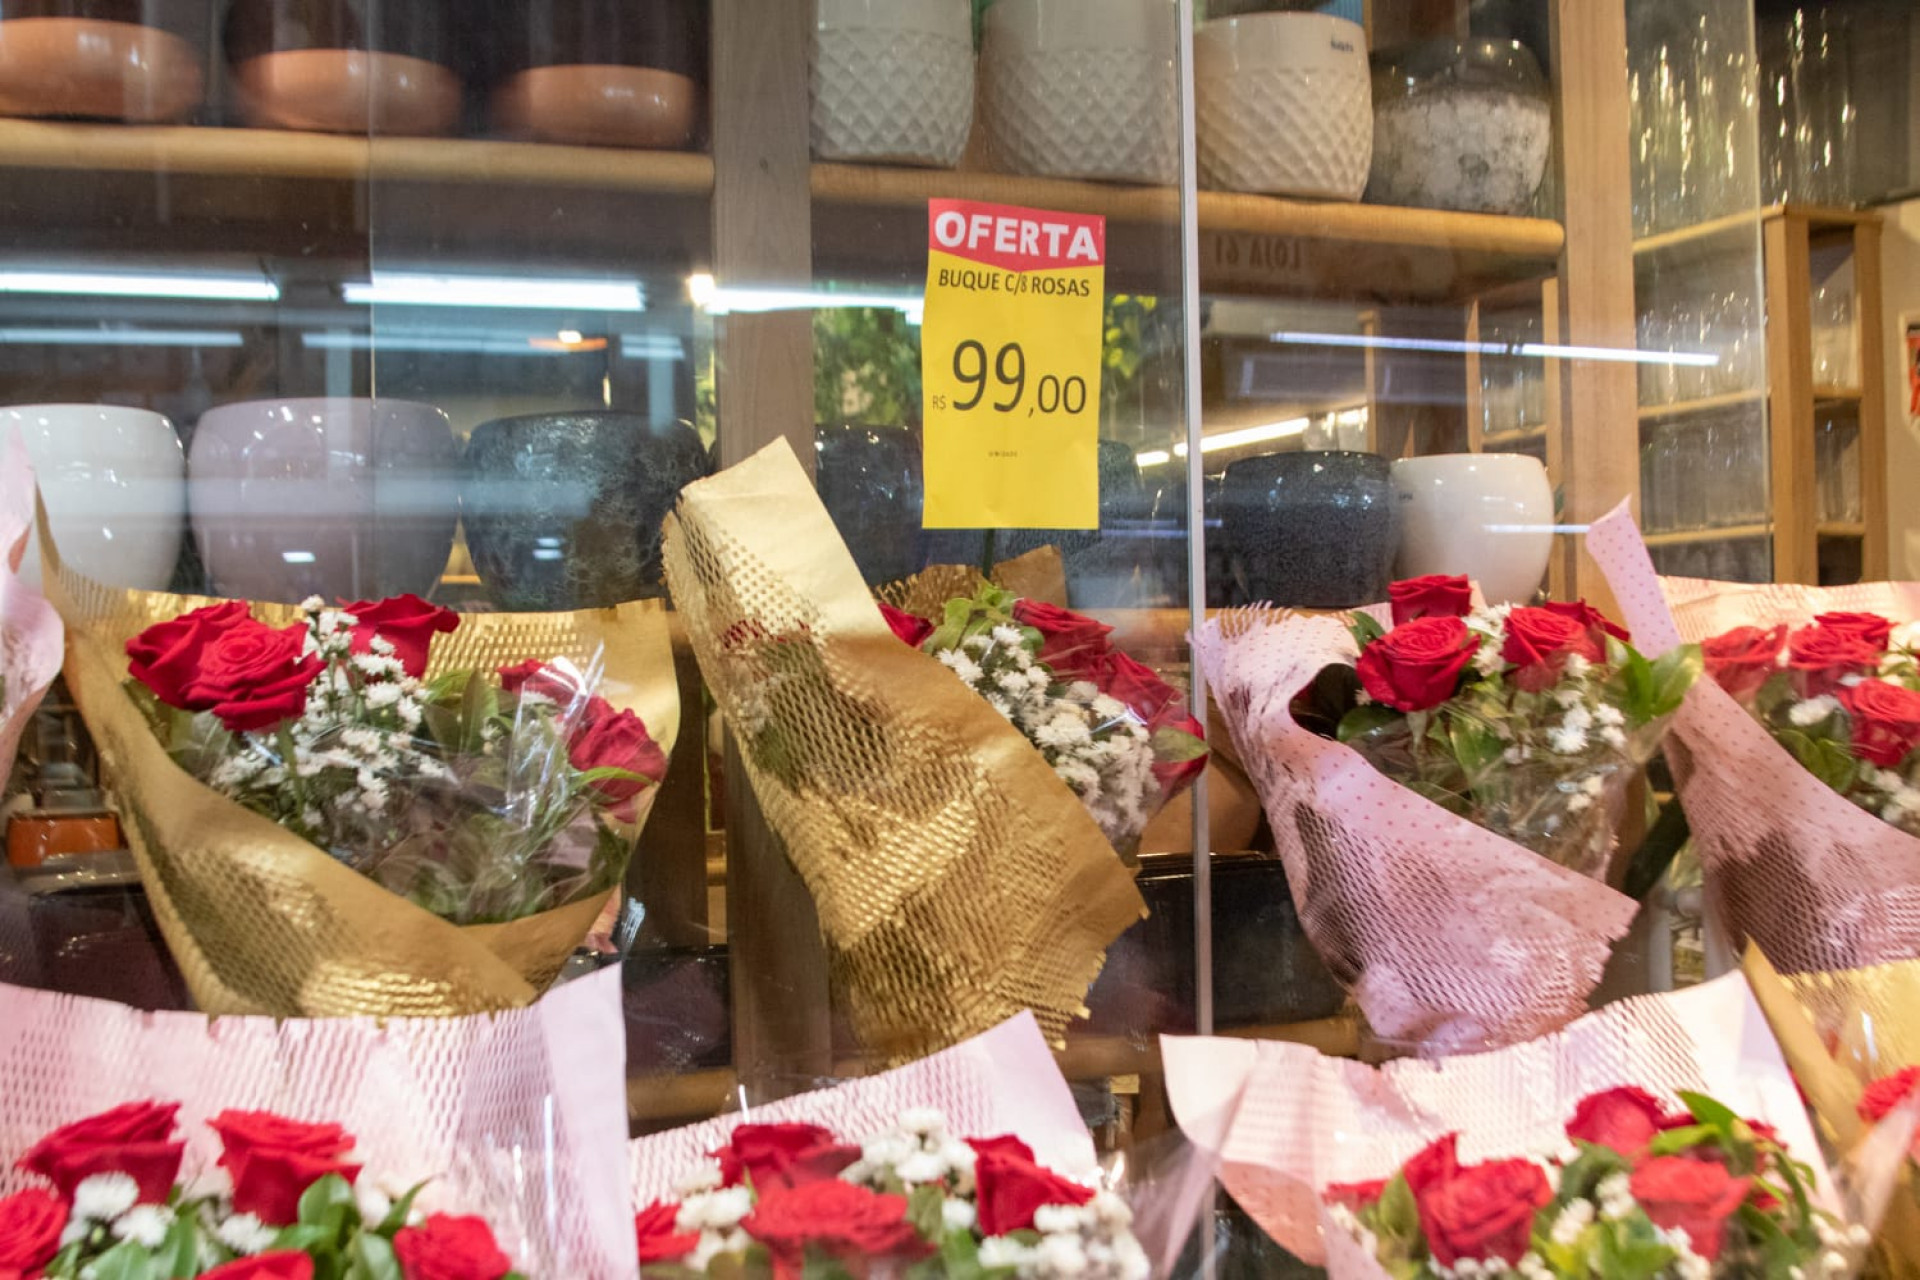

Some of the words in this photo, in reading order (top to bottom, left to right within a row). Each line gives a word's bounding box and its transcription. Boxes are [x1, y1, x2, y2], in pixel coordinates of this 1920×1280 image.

[934, 210, 1099, 262] OFERTA
[938, 268, 1000, 291] BUQUE
[1031, 276, 1090, 297] ROSAS
[932, 394, 947, 411] R$
[952, 338, 1087, 418] 99,00
